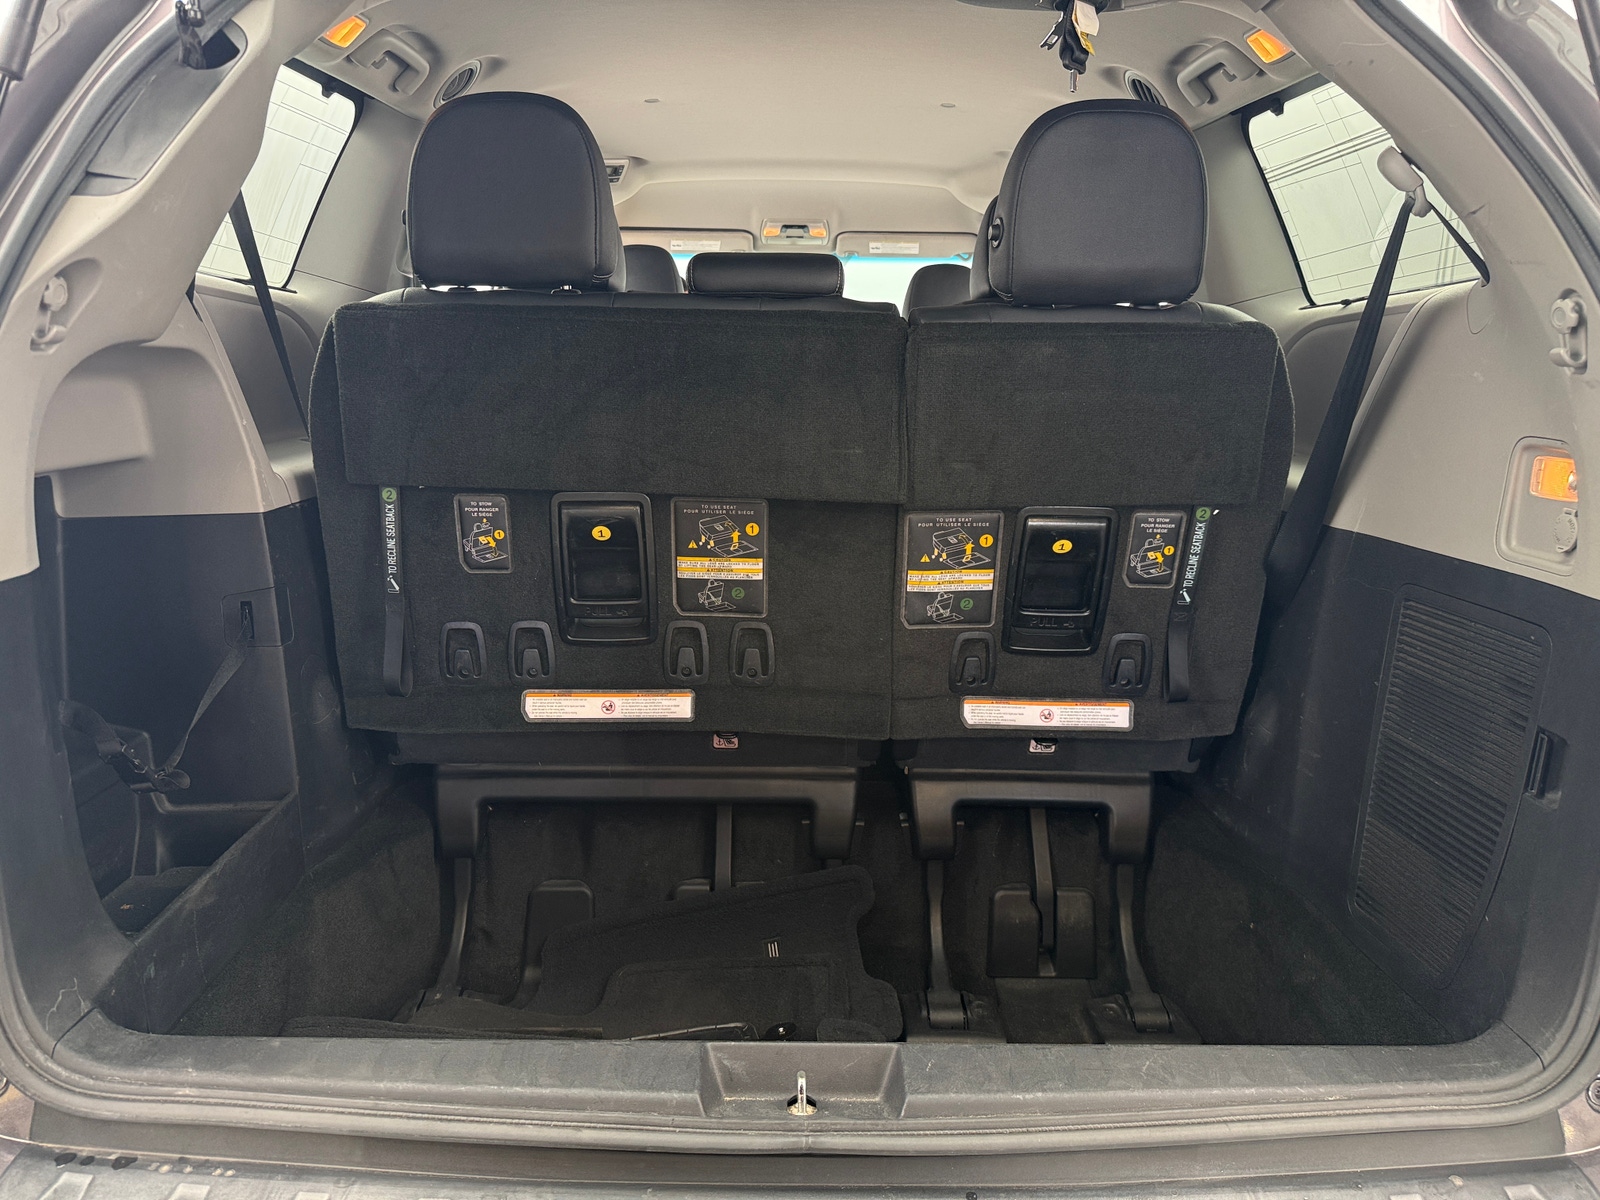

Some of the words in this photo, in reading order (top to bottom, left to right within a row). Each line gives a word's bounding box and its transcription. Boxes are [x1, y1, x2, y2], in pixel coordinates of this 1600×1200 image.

[385, 503, 396, 537] SEATBACK
[1190, 522, 1206, 554] SEATBACK
[386, 538, 397, 565] RECLINE
[388, 565, 397, 574] TO
[1185, 554, 1199, 579] RECLINE
[1183, 579, 1194, 587] TO
